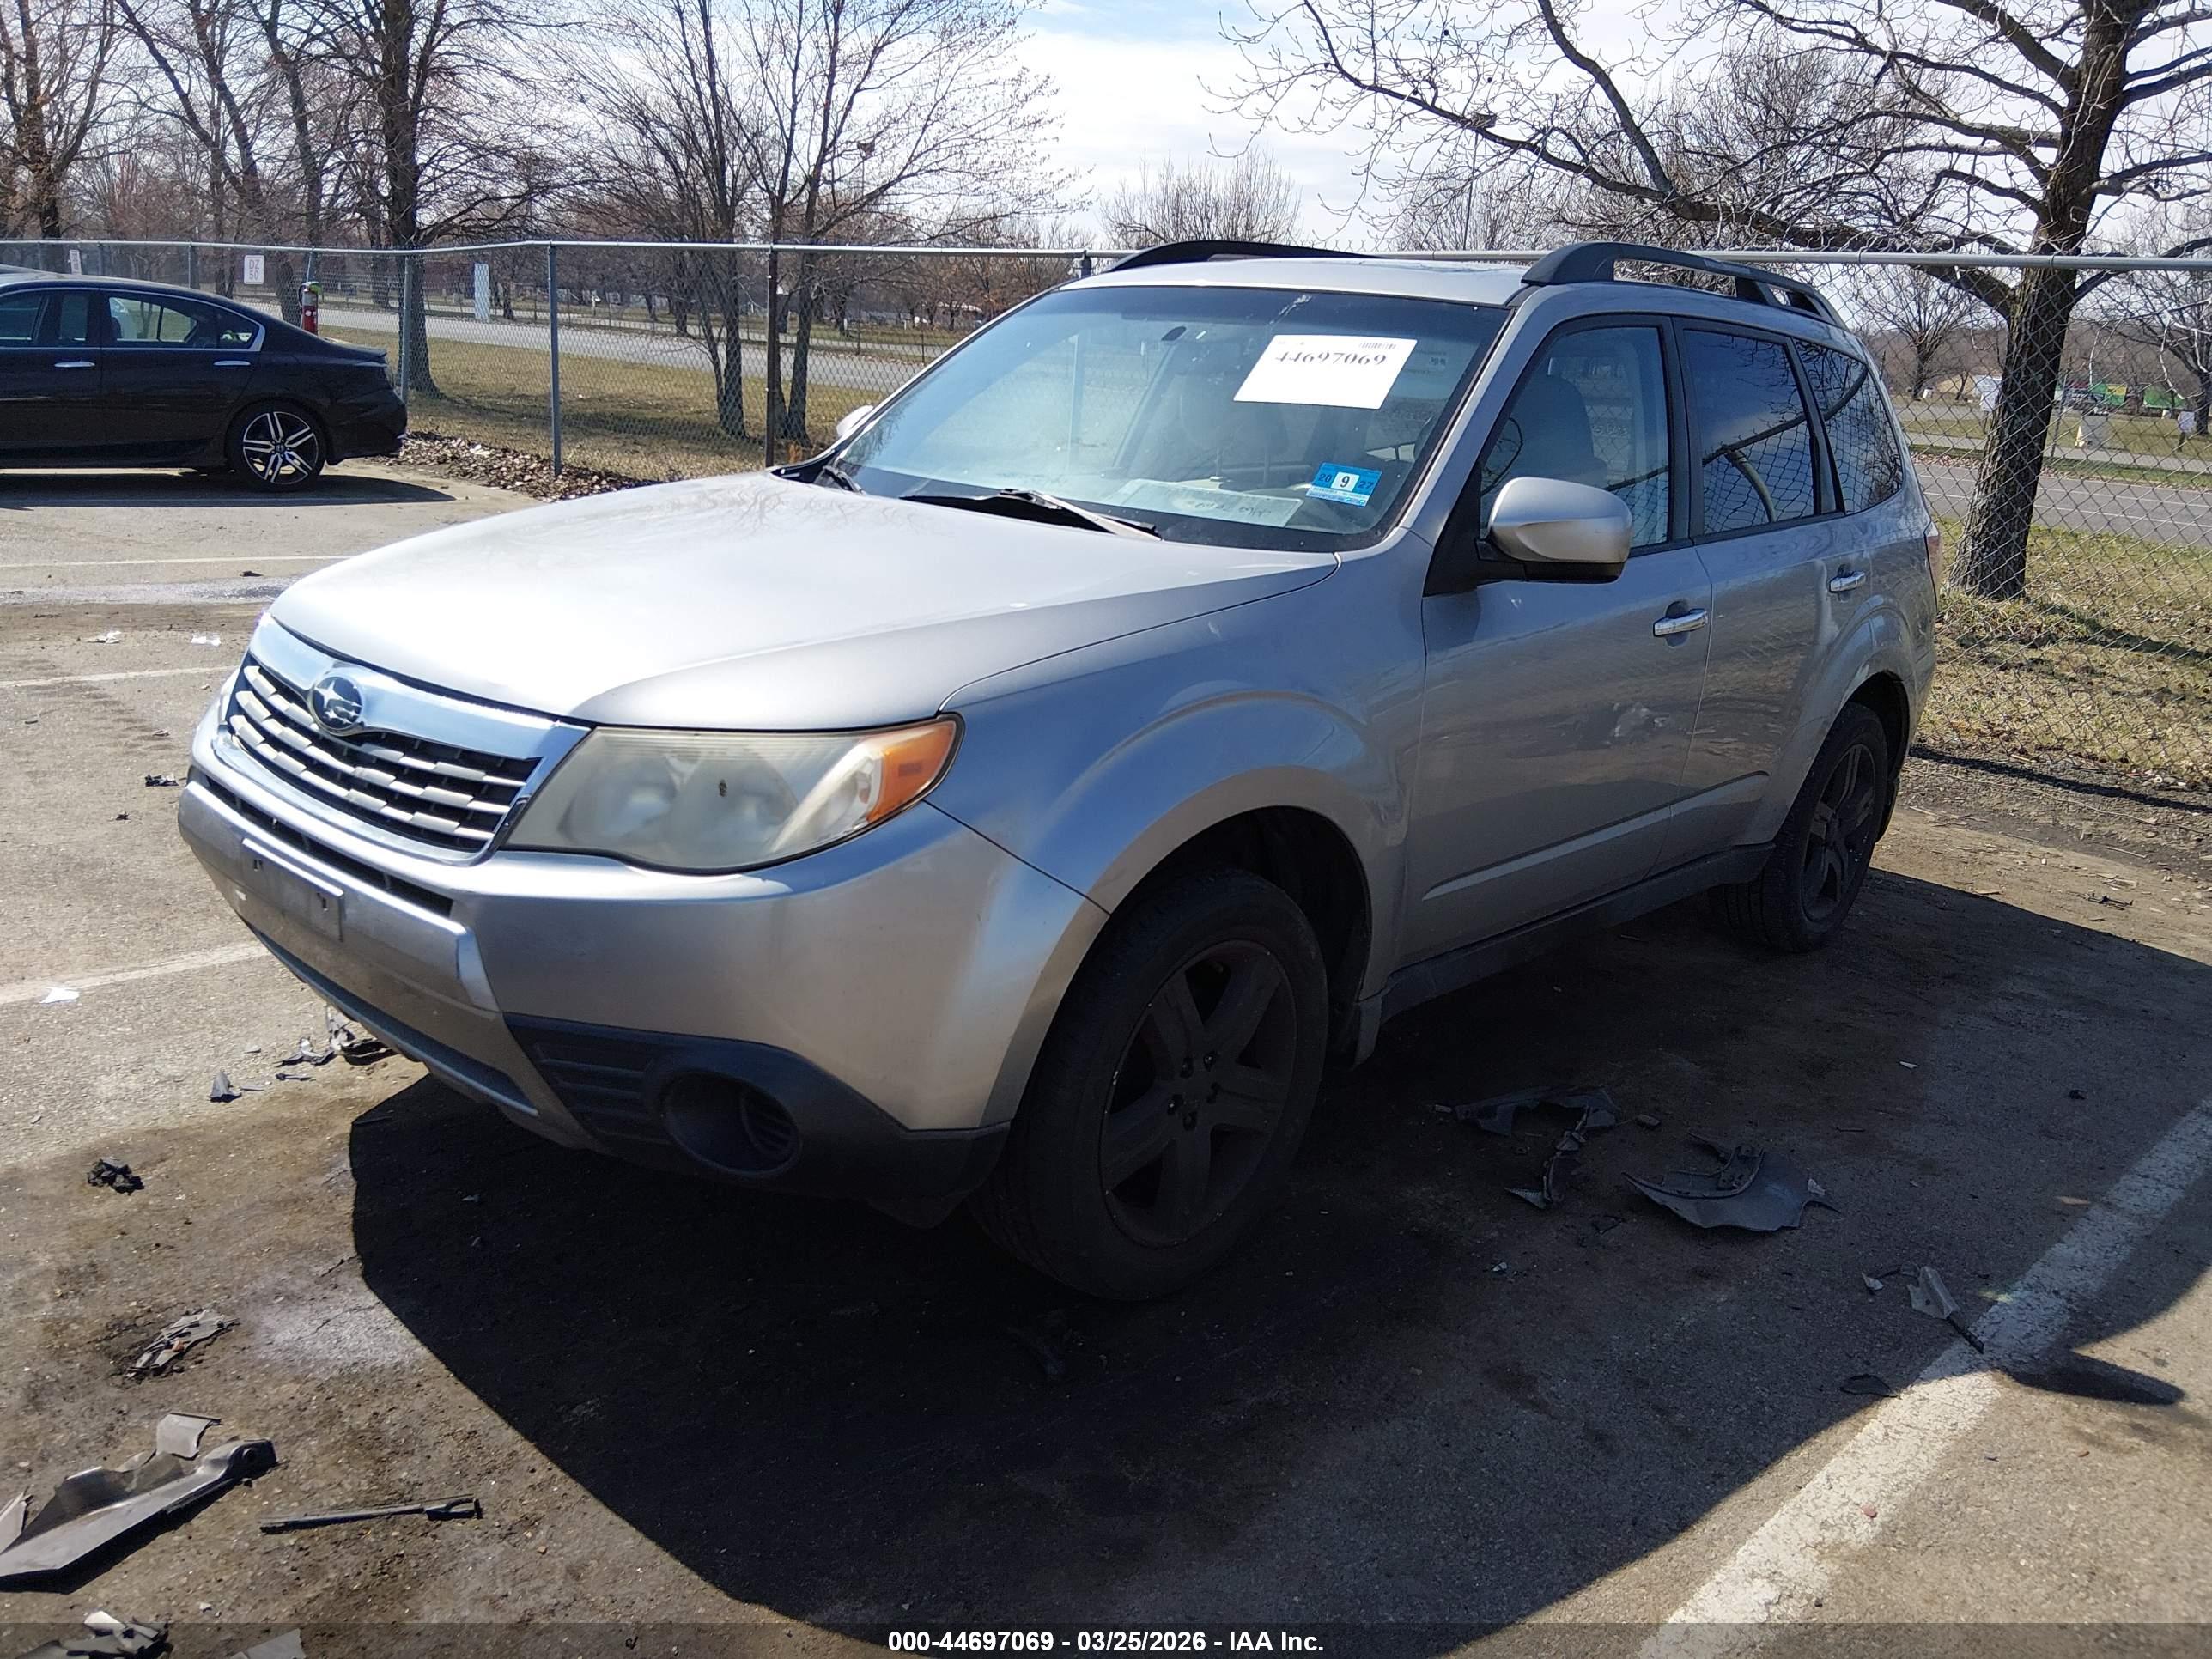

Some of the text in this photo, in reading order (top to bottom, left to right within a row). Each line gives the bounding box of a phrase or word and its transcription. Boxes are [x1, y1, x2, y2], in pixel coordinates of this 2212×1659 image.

[249, 270, 259, 281] 50
[1275, 351, 1387, 365] 44697069
[1318, 473, 1374, 490] 20 9 27
